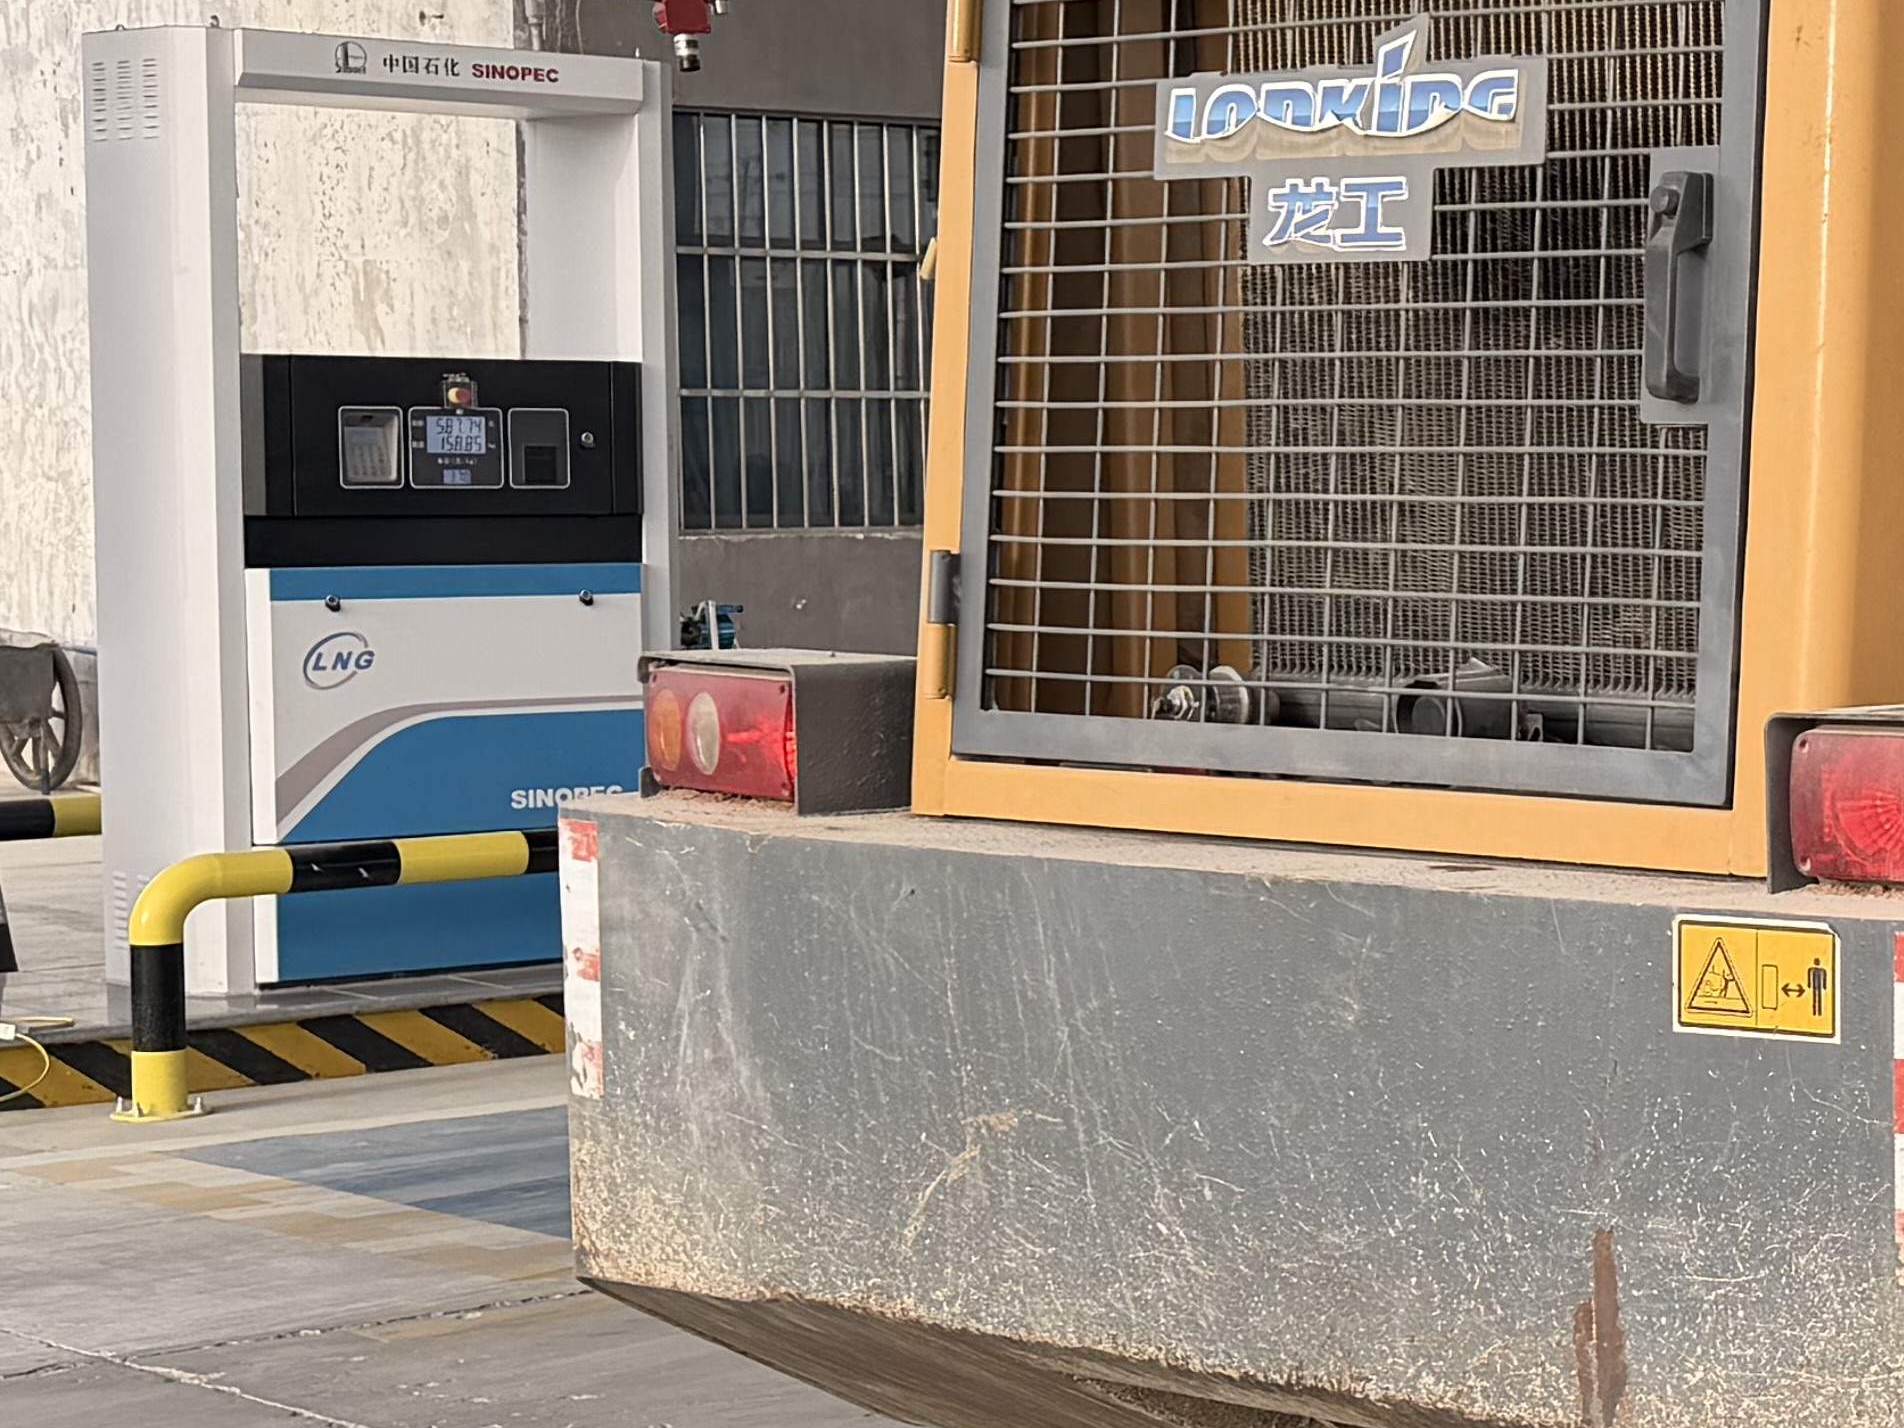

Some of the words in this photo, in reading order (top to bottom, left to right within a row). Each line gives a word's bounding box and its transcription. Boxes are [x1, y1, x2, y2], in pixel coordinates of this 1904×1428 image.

[382, 53, 461, 77] 中国石化
[471, 62, 560, 84] SINOPEC
[1263, 176, 1408, 252] 龙工
[311, 650, 376, 672] LNG
